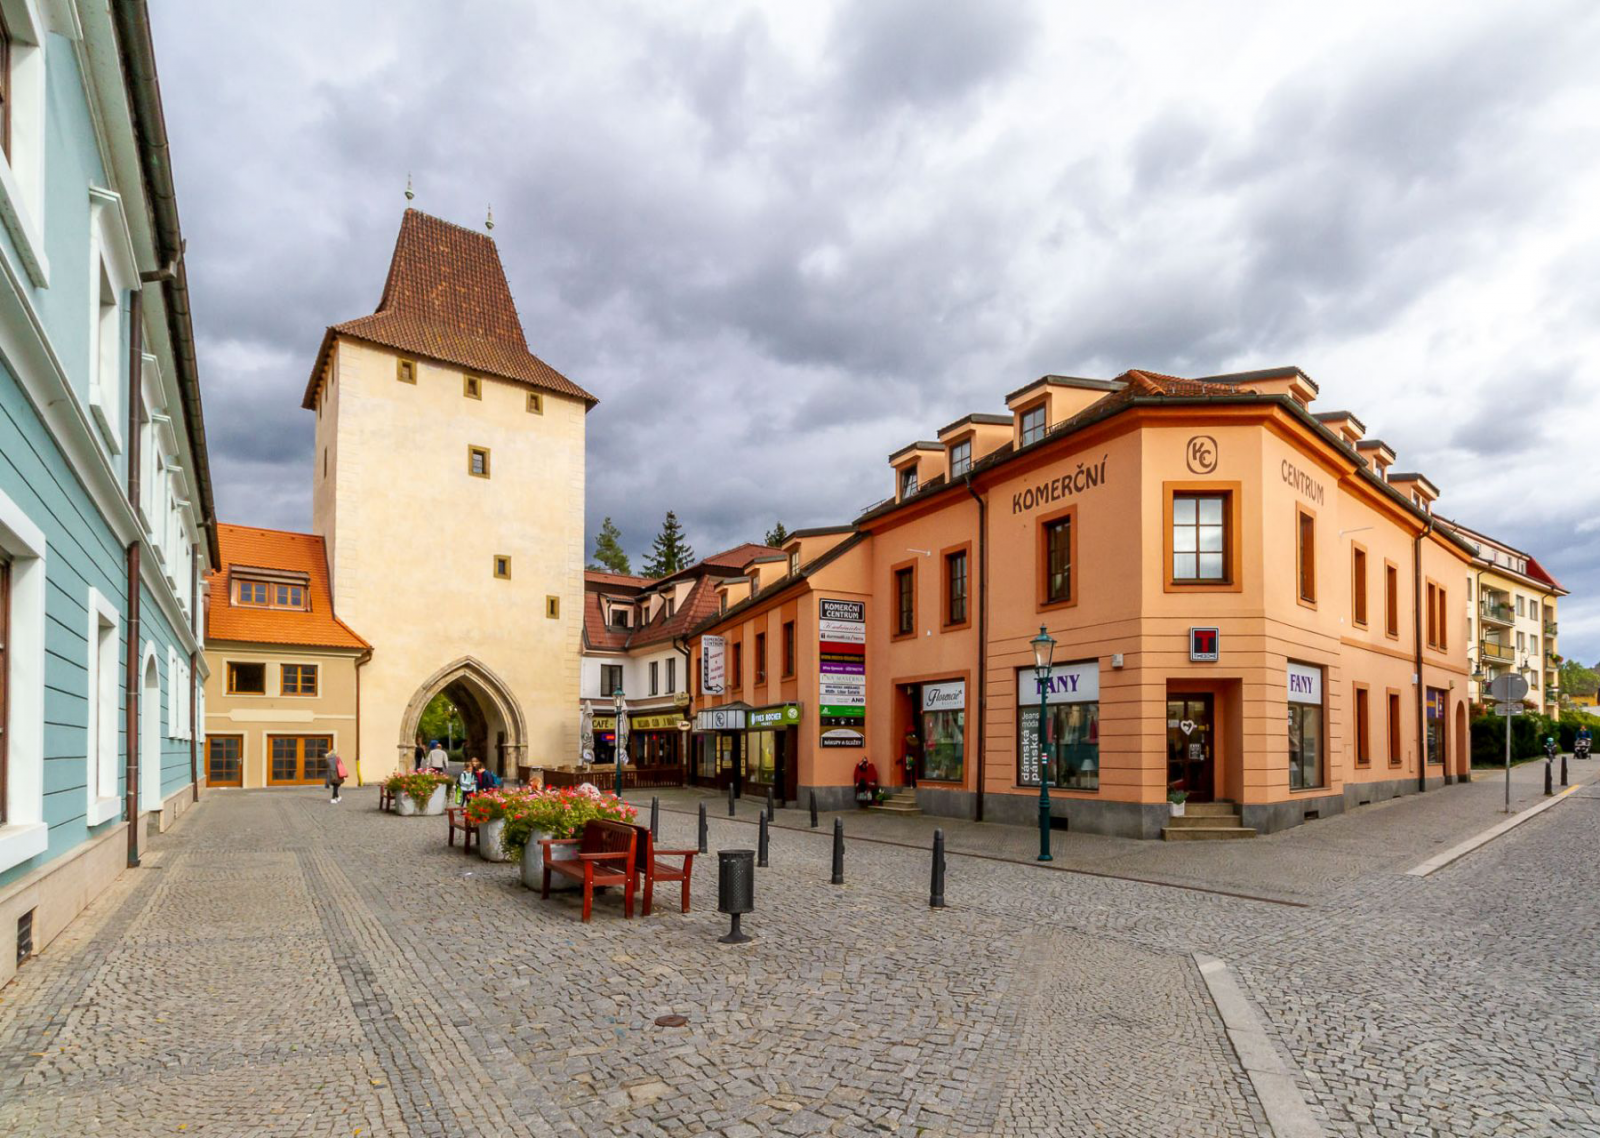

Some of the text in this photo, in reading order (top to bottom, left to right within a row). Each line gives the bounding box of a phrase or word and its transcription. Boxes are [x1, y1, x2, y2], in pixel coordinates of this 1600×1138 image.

[1012, 453, 1108, 515] KOMERČNÍ
[1281, 458, 1324, 507] CENTRUM
[824, 602, 860, 612] KOMERČNÍ
[826, 611, 859, 619] CENTRUM
[1290, 673, 1313, 694] FANY
[592, 718, 609, 728] CAFÉ
[1022, 711, 1039, 720] Jeans
[1021, 720, 1038, 728] móda
[1021, 729, 1030, 781] dámská
[1030, 733, 1040, 781] pánská
